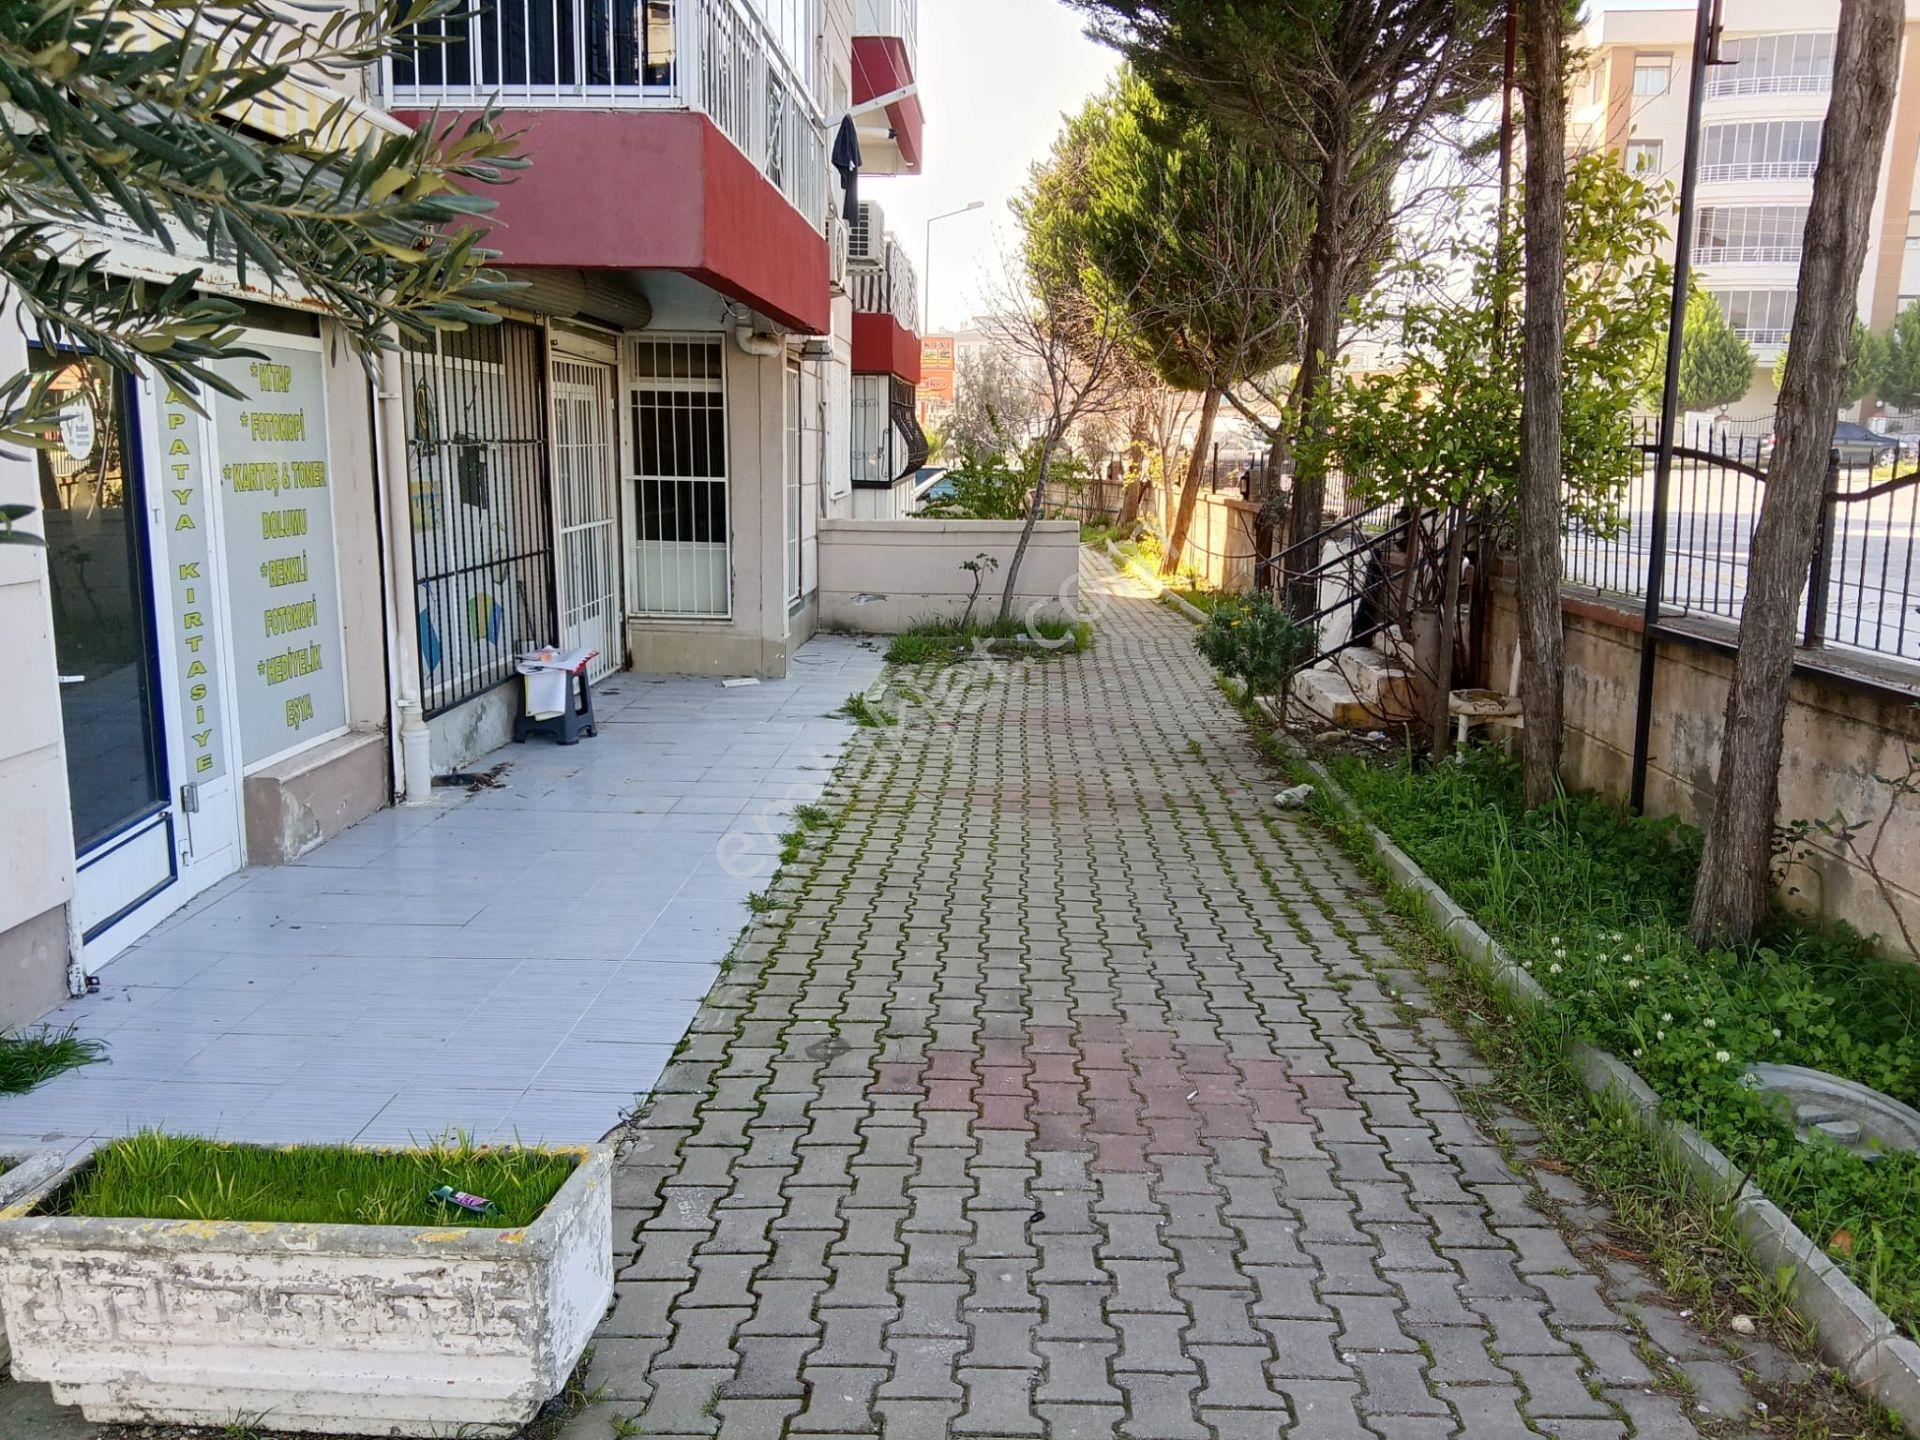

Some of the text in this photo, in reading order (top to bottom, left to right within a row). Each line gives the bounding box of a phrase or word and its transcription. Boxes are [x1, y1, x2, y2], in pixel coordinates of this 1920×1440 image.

[165, 360, 196, 531] APATYA
[291, 460, 327, 488] TONER
[261, 508, 308, 540] DOLUMU
[264, 593, 318, 638] FOTOKOPİ
[179, 562, 214, 774] KIRTASİYE
[285, 693, 314, 731] EŞYA
